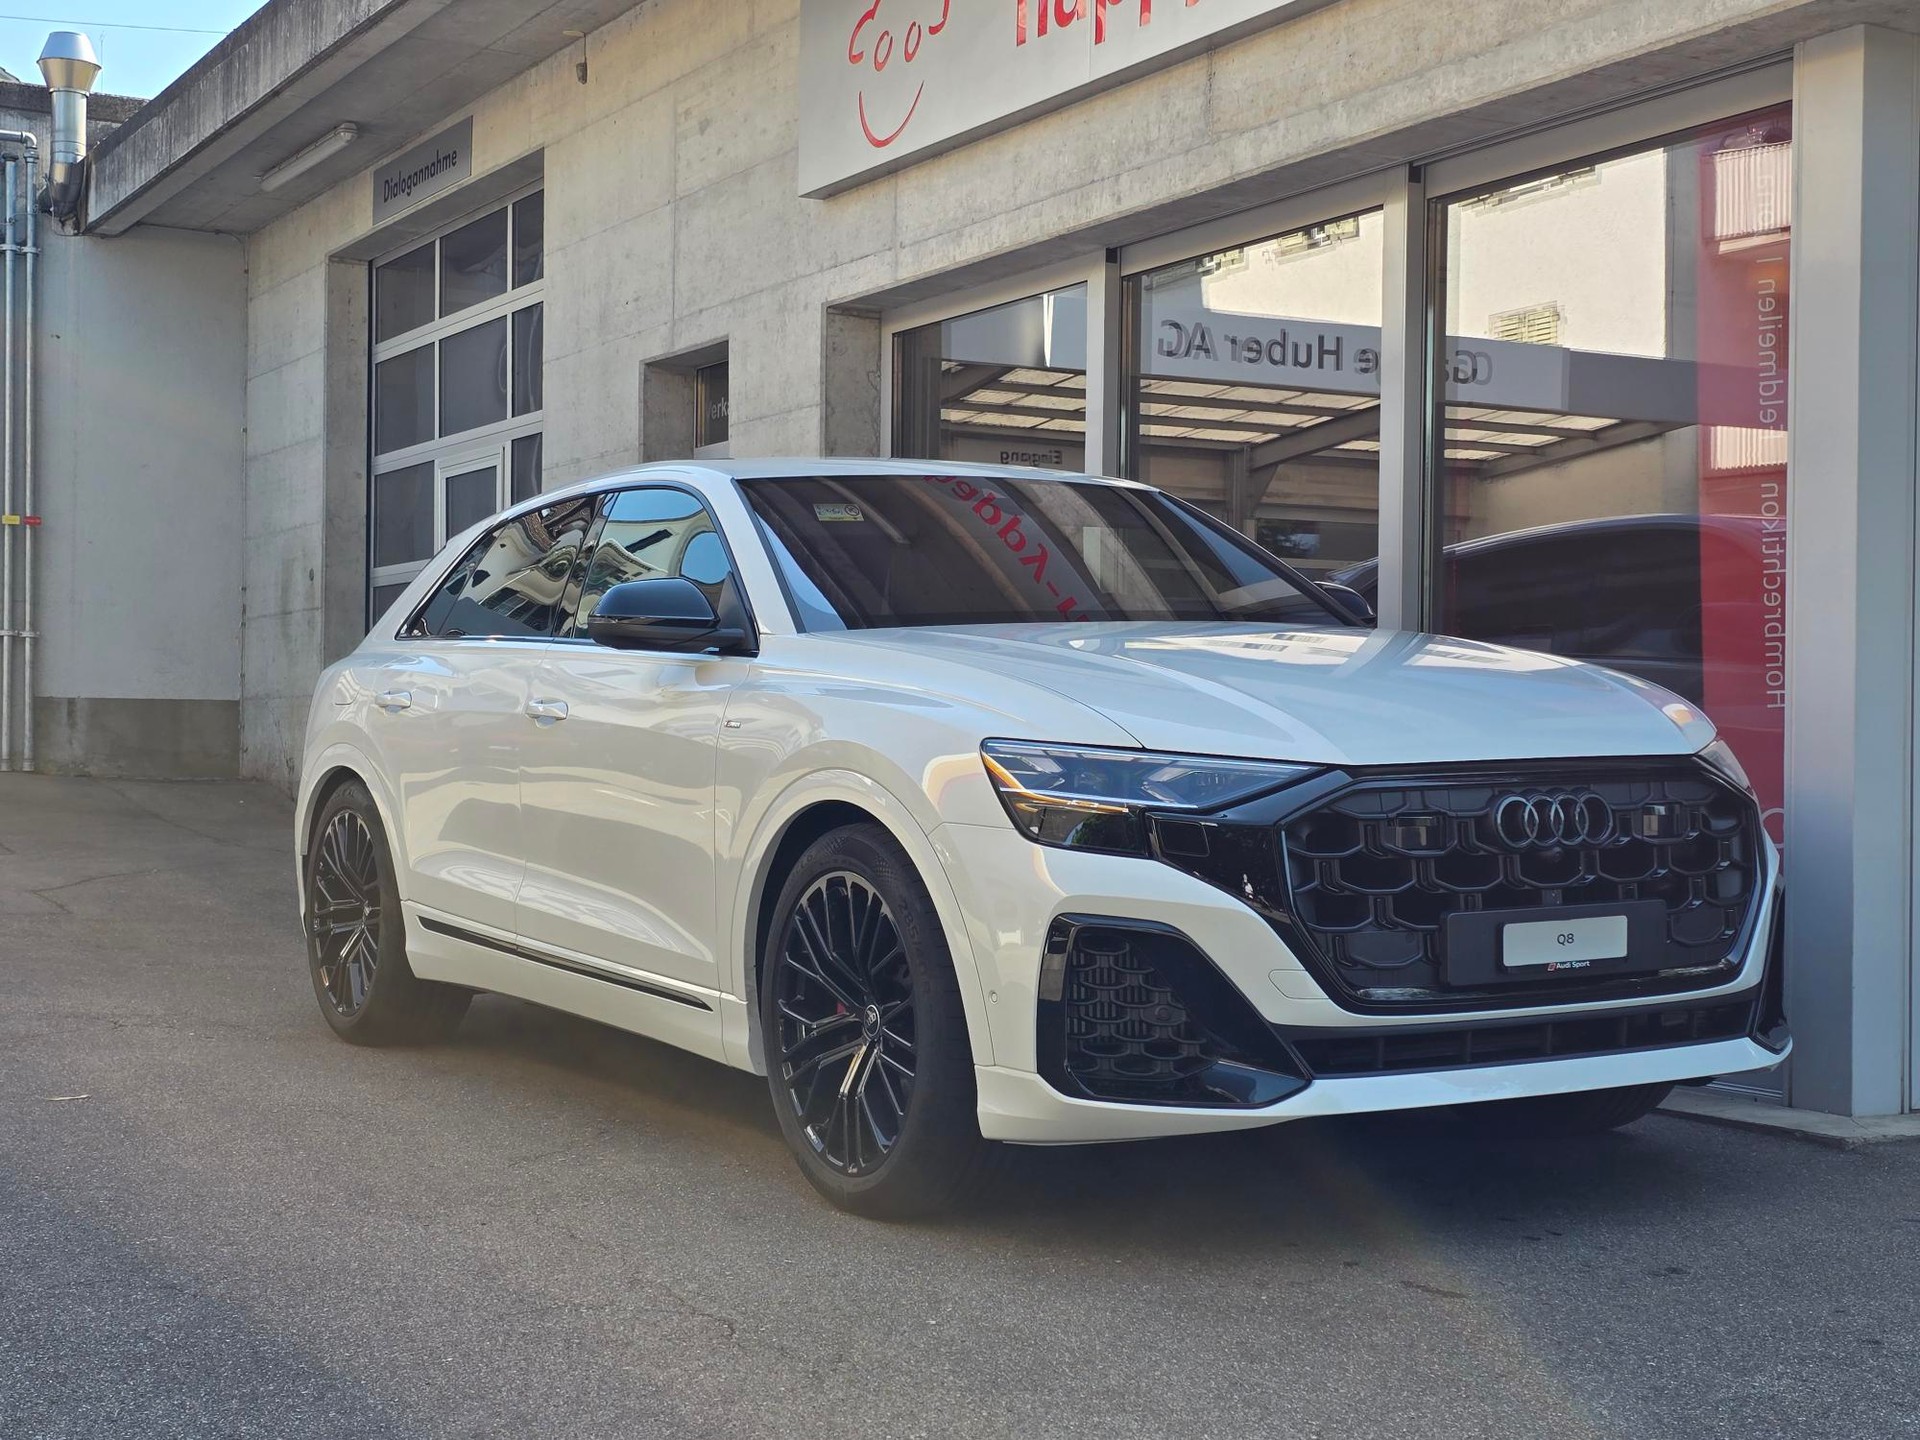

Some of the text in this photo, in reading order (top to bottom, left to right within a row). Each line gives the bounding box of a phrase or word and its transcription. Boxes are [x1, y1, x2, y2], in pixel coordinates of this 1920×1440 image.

[383, 149, 458, 203] Dialogannahme
[1556, 933, 1575, 946] Q8
[1556, 960, 1590, 970] Audi Sport
